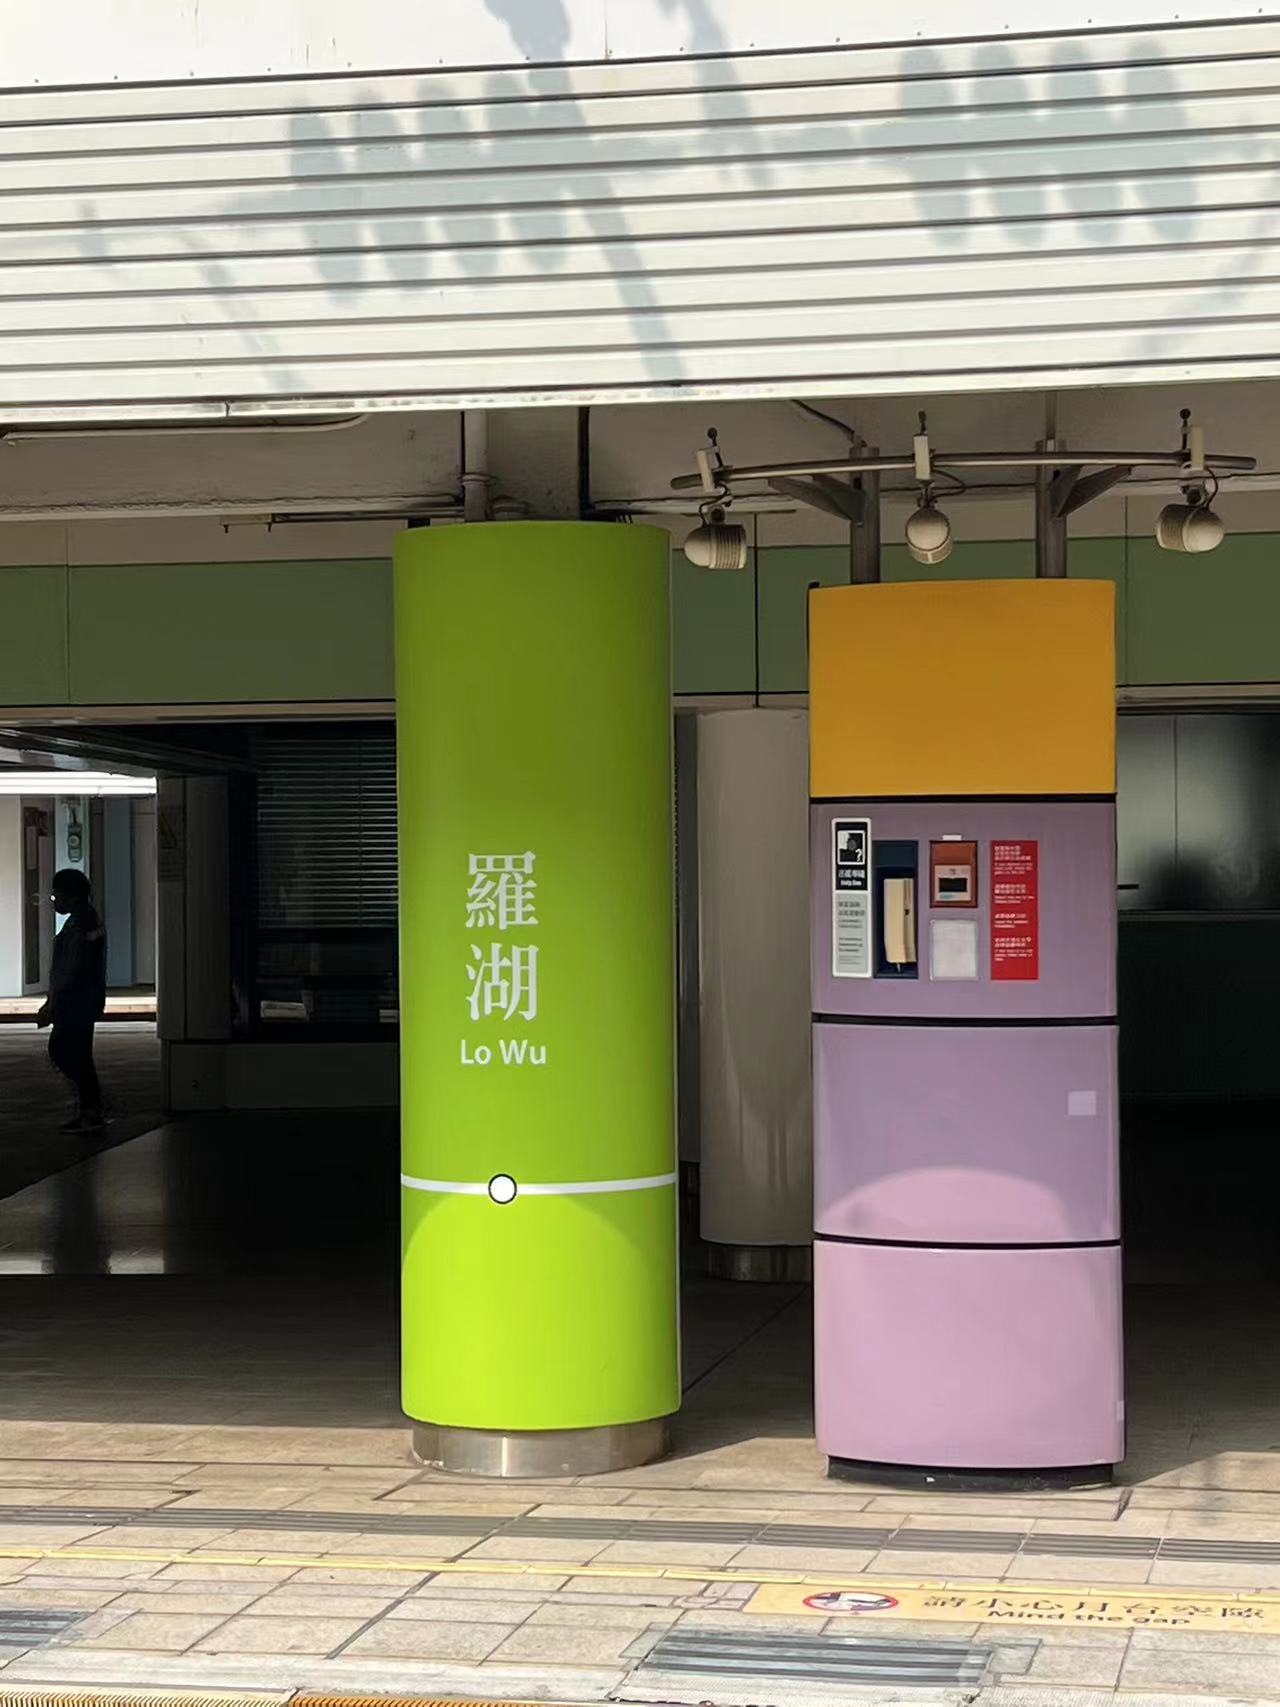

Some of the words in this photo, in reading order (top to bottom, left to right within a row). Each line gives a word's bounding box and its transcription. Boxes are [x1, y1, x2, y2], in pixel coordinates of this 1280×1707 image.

[465, 851, 539, 1021] 羅湖
[460, 1039, 492, 1065] Lo
[499, 1039, 547, 1065] Wu
[988, 1610, 1065, 1620] Mind
[1075, 1613, 1123, 1622] the
[1132, 1616, 1191, 1625] gap
